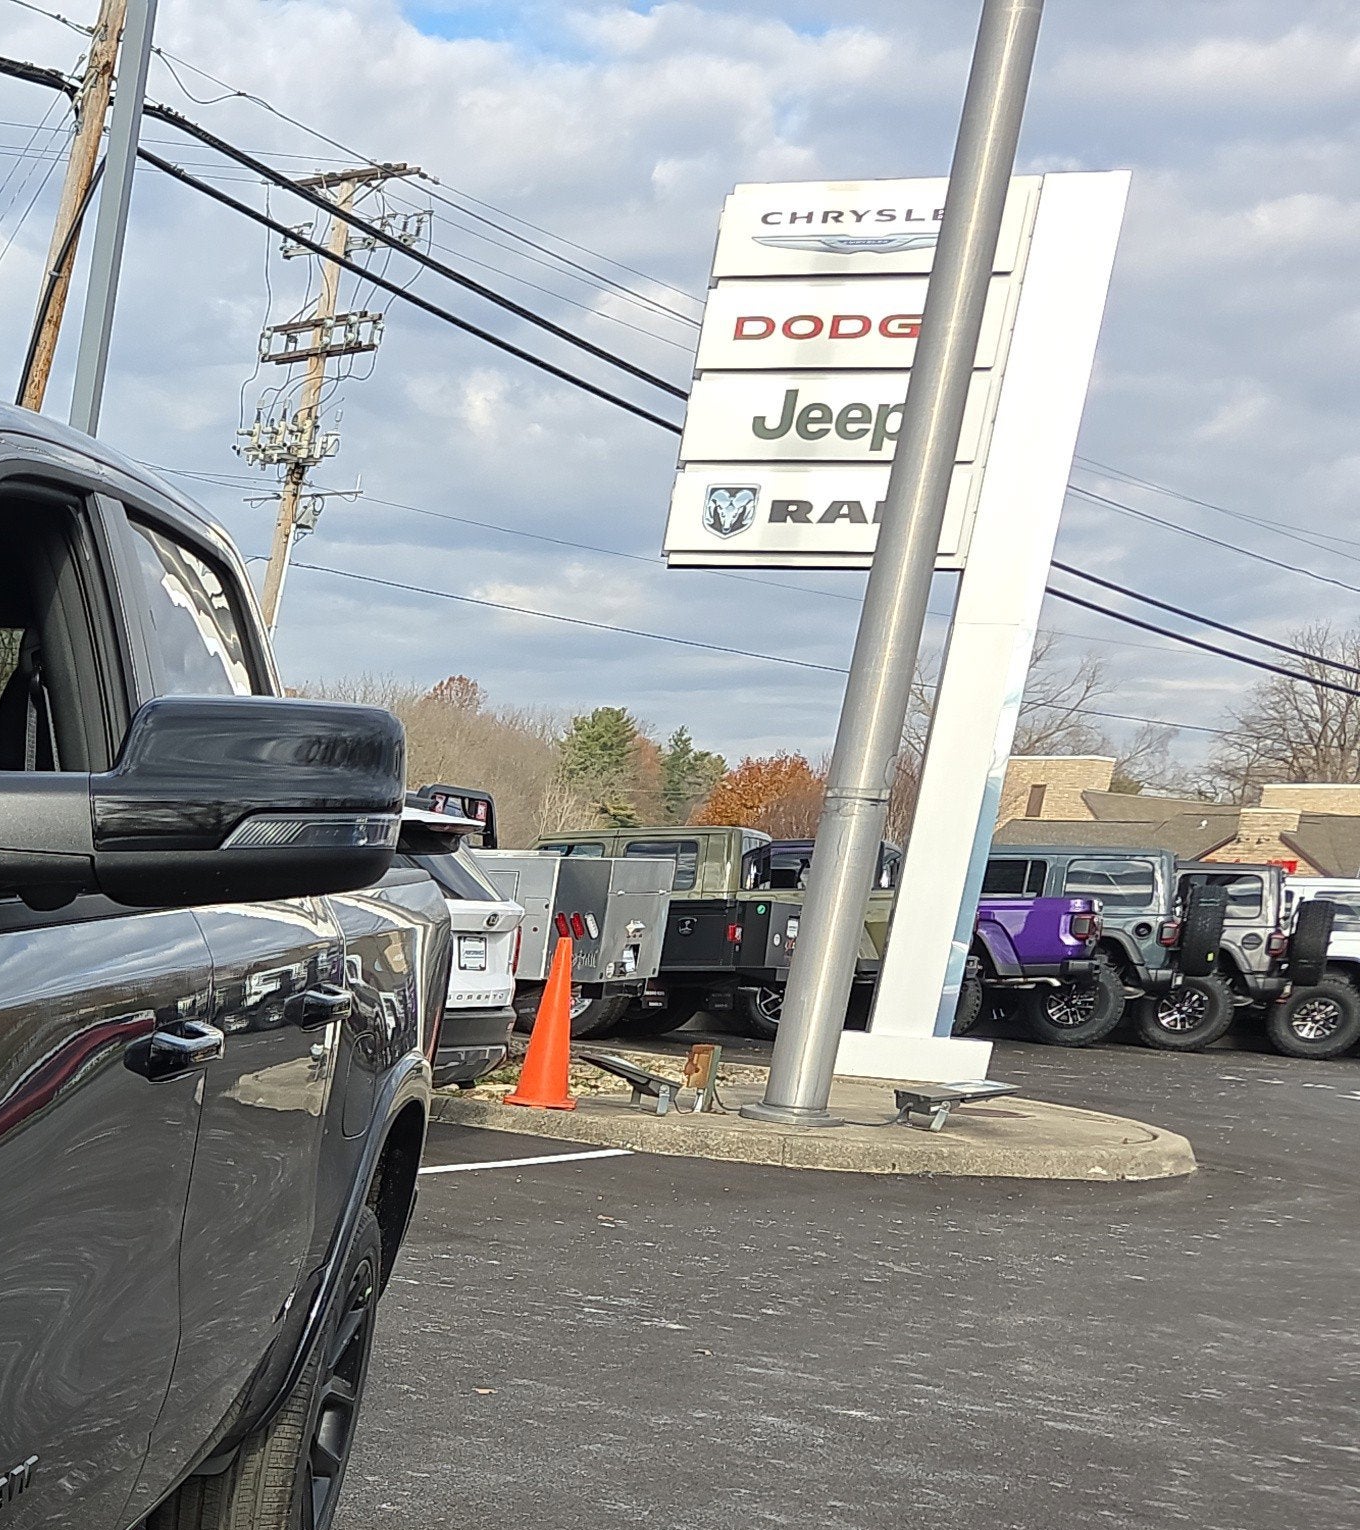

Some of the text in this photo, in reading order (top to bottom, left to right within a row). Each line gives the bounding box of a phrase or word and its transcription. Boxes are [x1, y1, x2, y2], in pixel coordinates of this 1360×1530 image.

[760, 208, 946, 226] CHRYSLE
[733, 313, 924, 341] DODG
[751, 388, 906, 451] Jeep
[767, 499, 887, 524] RA
